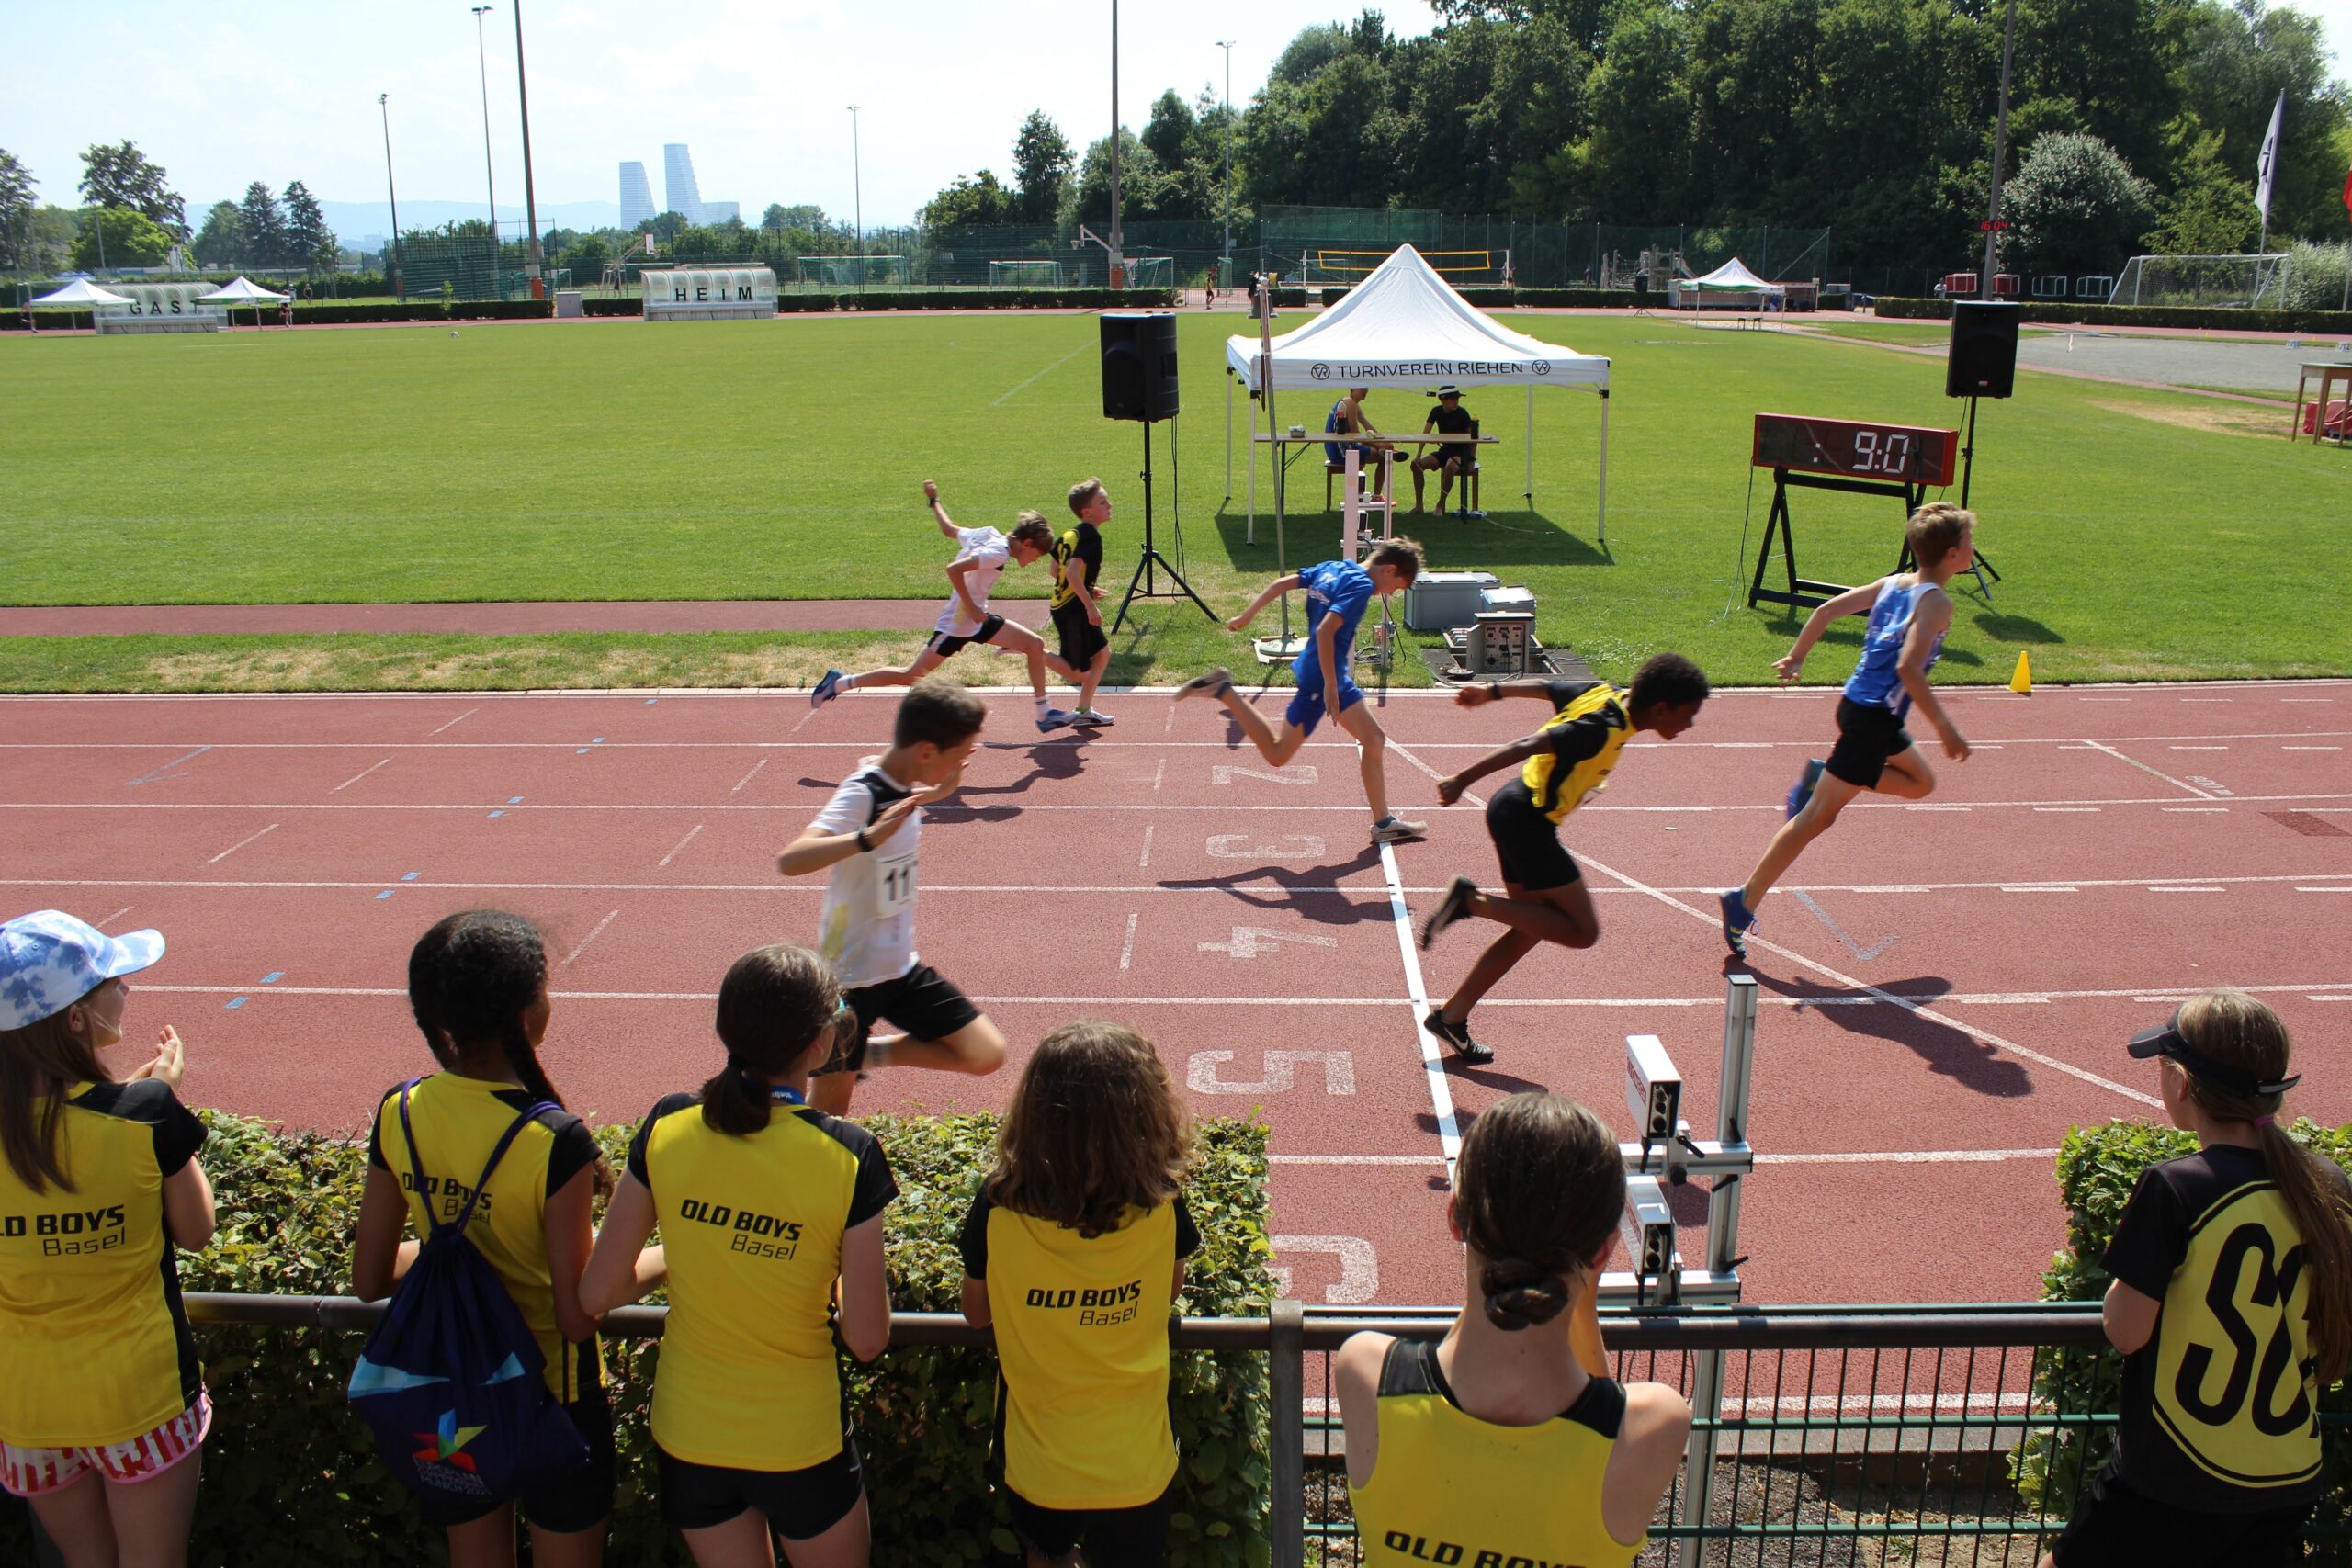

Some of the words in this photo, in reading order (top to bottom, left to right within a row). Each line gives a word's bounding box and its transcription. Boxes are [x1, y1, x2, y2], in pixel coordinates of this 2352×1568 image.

[675, 286, 752, 301] HEIM
[1337, 362, 1452, 378] TURNVEREIN
[1458, 359, 1523, 375] RIEHEN
[1197, 926, 1339, 958] 4
[1186, 1049, 1356, 1096] 5
[36, 1204, 125, 1235] BOYS
[680, 1199, 731, 1226] OLD
[733, 1211, 803, 1242] BOYS
[43, 1226, 125, 1256] Basel
[730, 1234, 797, 1260] Basel
[1026, 1288, 1076, 1308] OLD
[1080, 1280, 1142, 1307] BOYS
[1080, 1301, 1138, 1326] Basel
[1385, 1530, 1464, 1566] OLD
